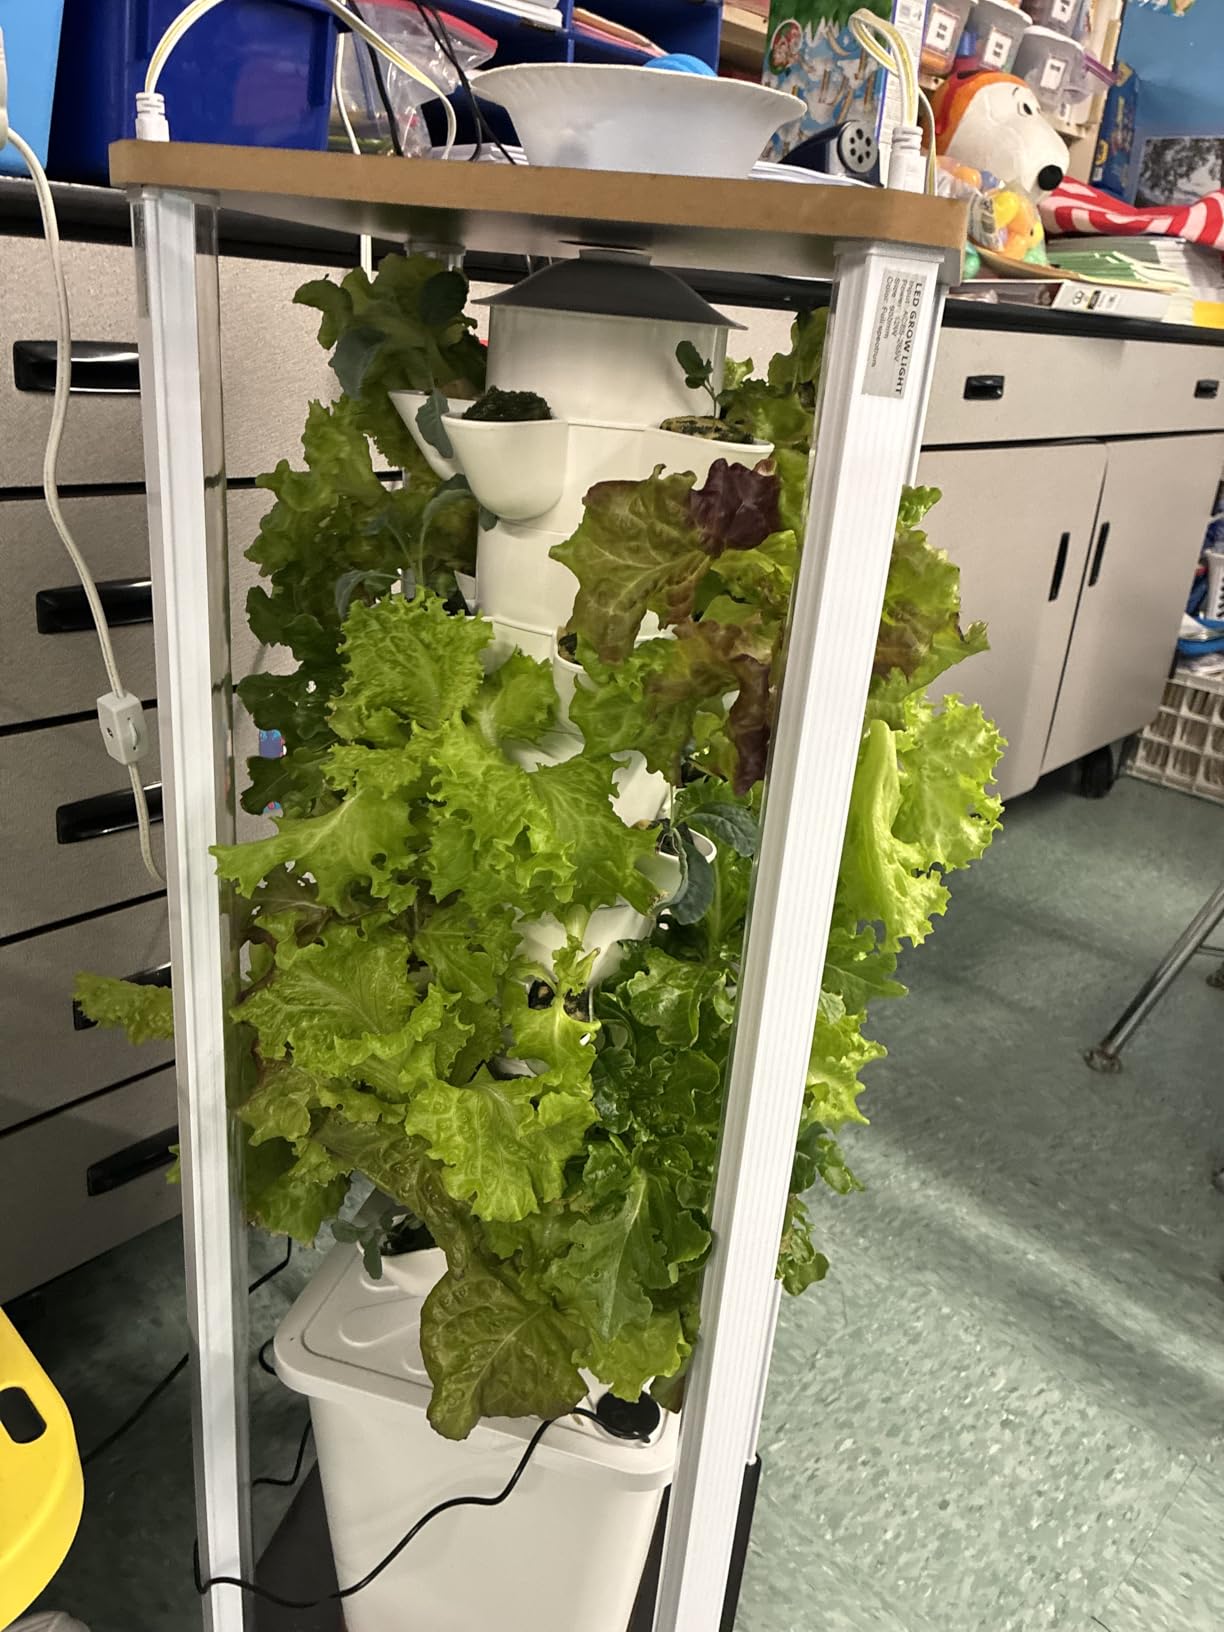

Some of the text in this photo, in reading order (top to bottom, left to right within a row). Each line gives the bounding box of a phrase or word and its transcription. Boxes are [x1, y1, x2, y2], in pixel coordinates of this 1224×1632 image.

[895, 282, 923, 395] LED GROW LIGHT
